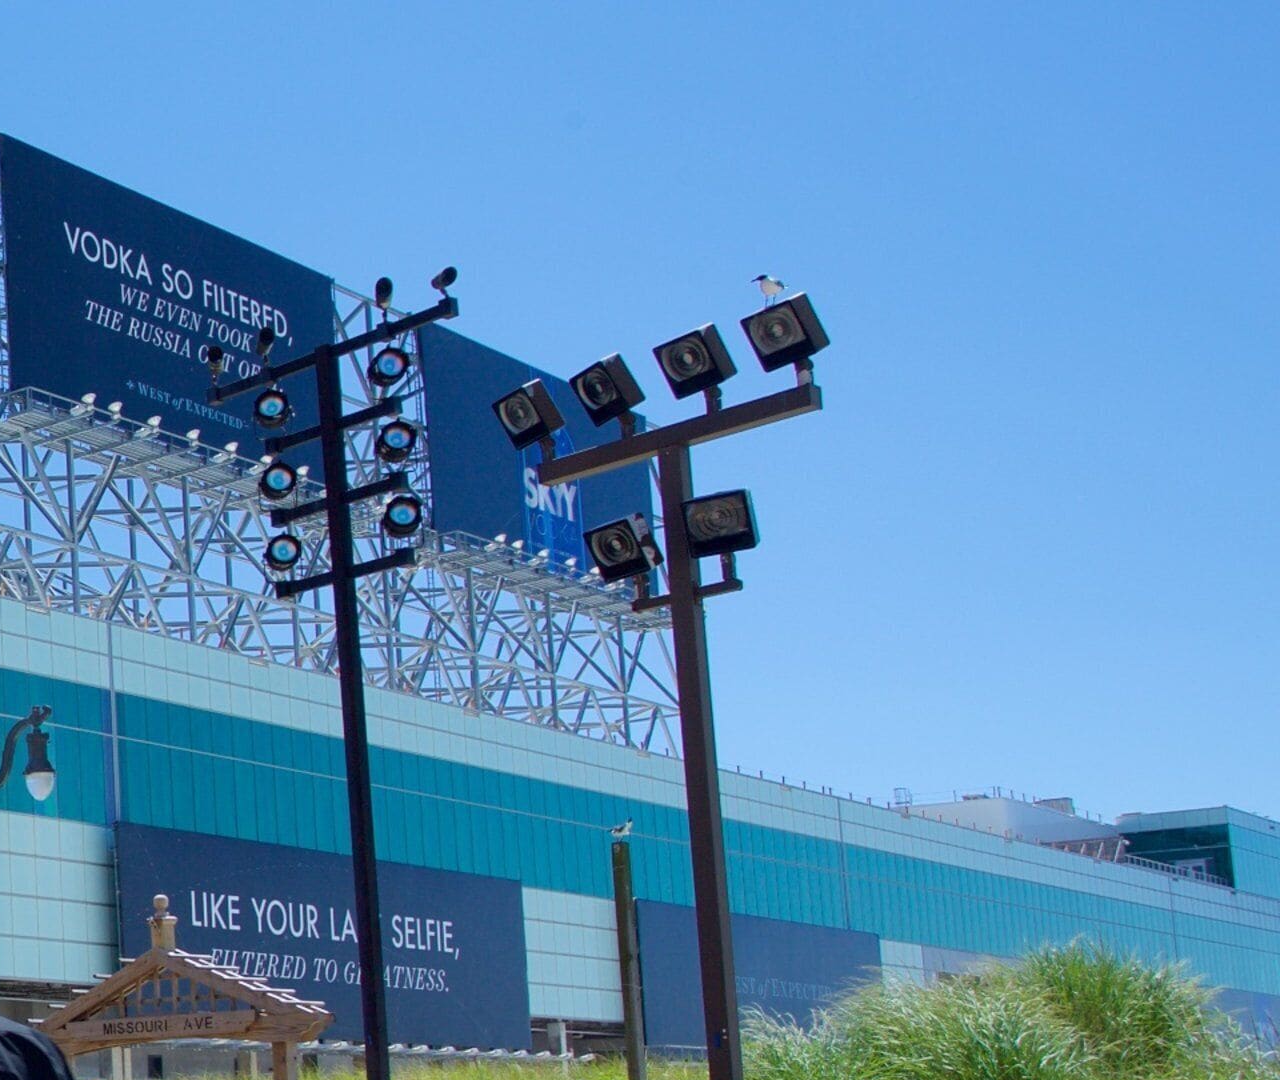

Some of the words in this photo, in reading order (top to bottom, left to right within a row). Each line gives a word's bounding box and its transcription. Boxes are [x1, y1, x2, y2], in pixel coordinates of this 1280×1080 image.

[63, 222, 152, 285] VODKA
[161, 263, 193, 300] SO
[84, 300, 123, 332] THE
[128, 317, 191, 358] RUSSIA
[197, 344, 235, 374] OT
[120, 283, 150, 313] WE
[154, 297, 202, 332] EVEN
[207, 318, 254, 353] TOOK
[138, 381, 170, 406] WEST
[524, 467, 577, 522] SKYY
[190, 890, 240, 931] LIKE
[251, 897, 320, 939] YOUR
[391, 914, 460, 961] SELFIE,
[313, 957, 338, 983] TO
[343, 960, 450, 993] GATNESS.
[736, 975, 757, 994] EST
[102, 1019, 168, 1035] MISSOURI
[184, 1016, 213, 1032] AVE
